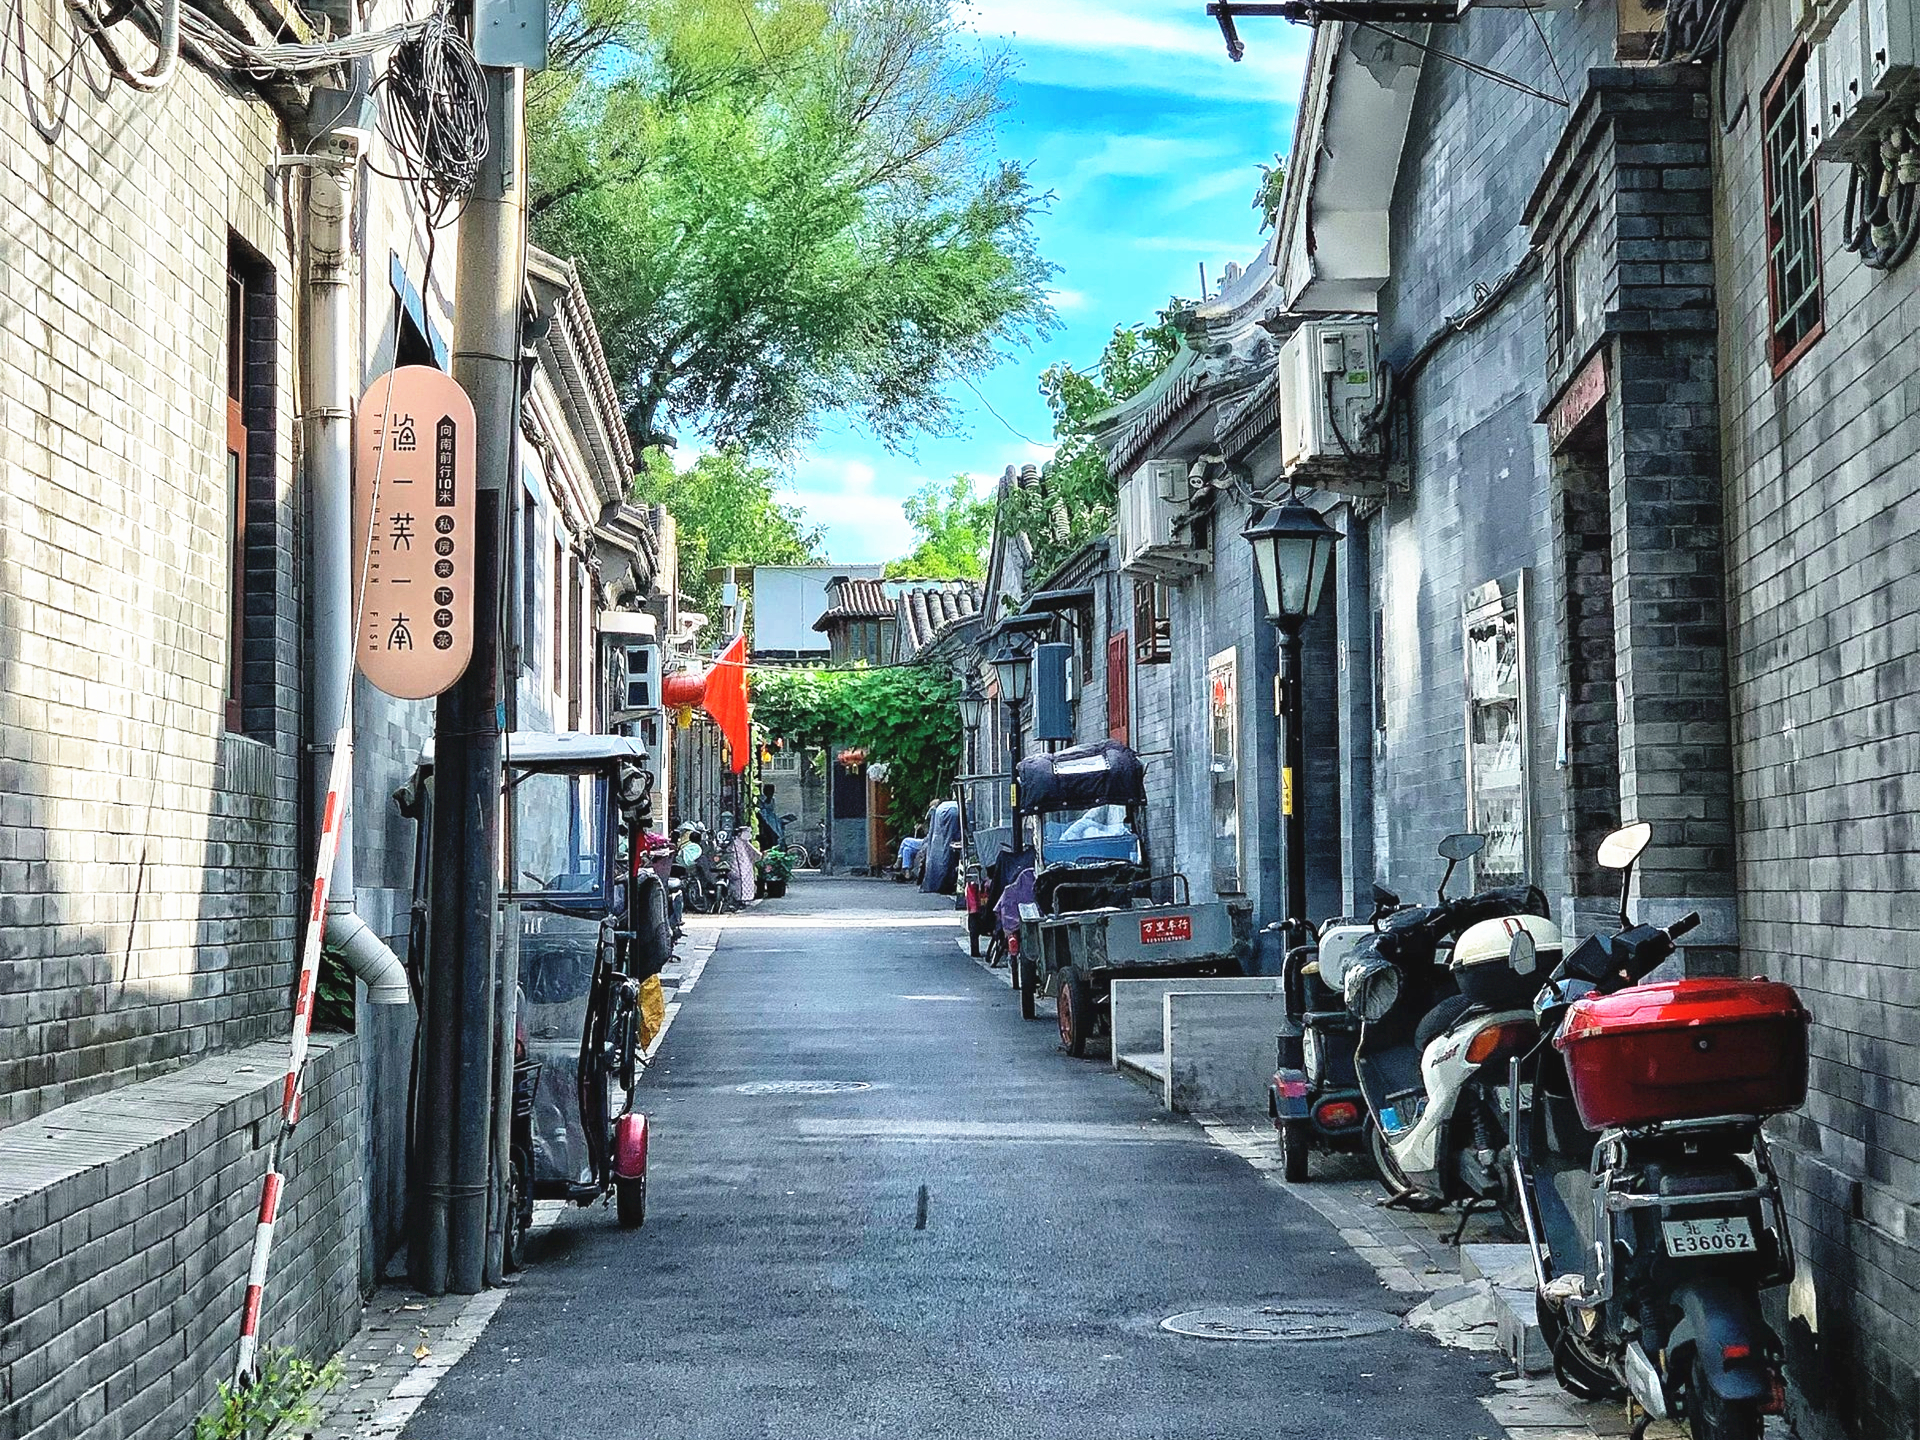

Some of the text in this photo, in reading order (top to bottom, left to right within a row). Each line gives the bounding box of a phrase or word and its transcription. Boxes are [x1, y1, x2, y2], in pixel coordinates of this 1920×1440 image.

[373, 413, 382, 452] THE
[438, 424, 453, 503] 向南前行10米
[435, 517, 453, 648] 私房菜 下午茶
[369, 611, 379, 651] FISH
[1673, 1233, 1750, 1252] E36062
